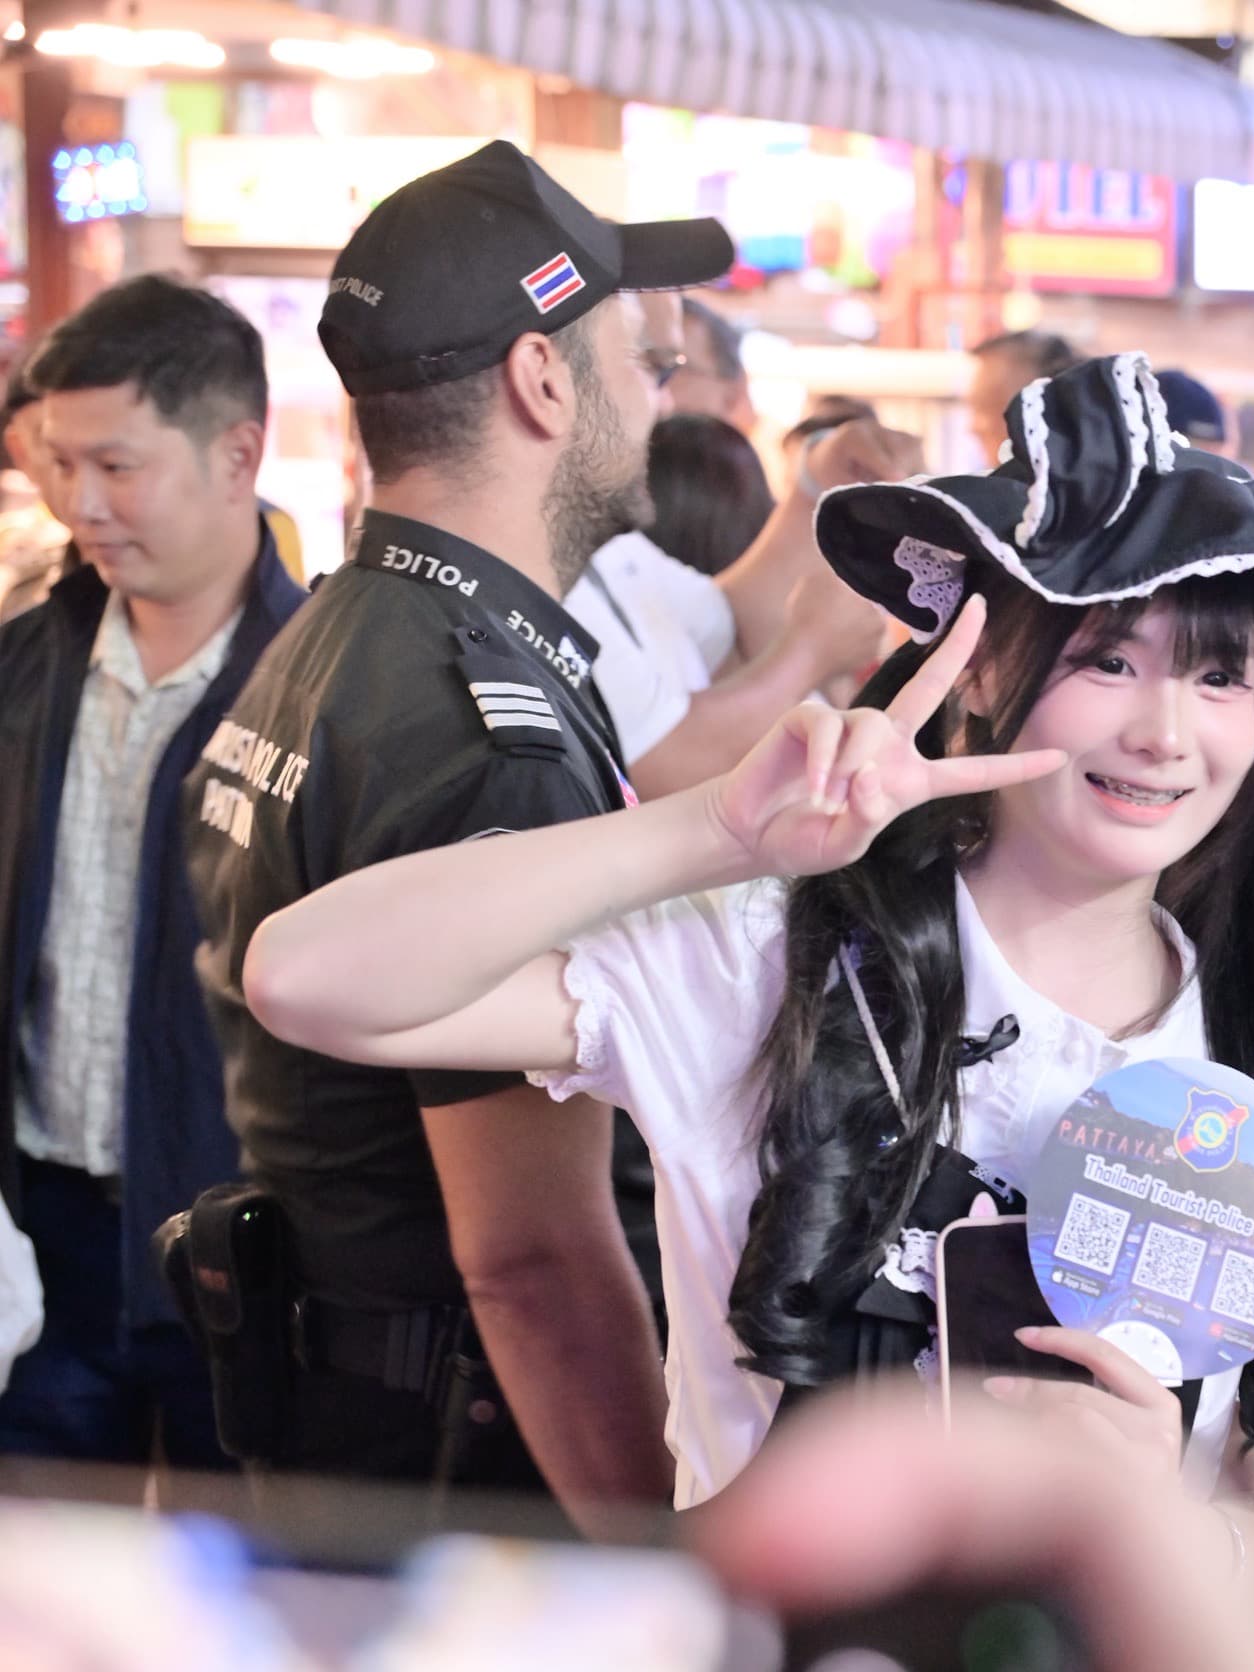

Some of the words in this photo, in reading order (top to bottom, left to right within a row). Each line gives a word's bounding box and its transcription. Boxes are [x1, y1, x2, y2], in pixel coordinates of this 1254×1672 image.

[381, 544, 480, 598] POLICE
[505, 609, 581, 690] POLICE
[1058, 1119, 1156, 1159] PATTAYA
[1085, 1154, 1151, 1198] Thailand
[1151, 1178, 1206, 1219] Tourist
[1205, 1200, 1254, 1236] Police
